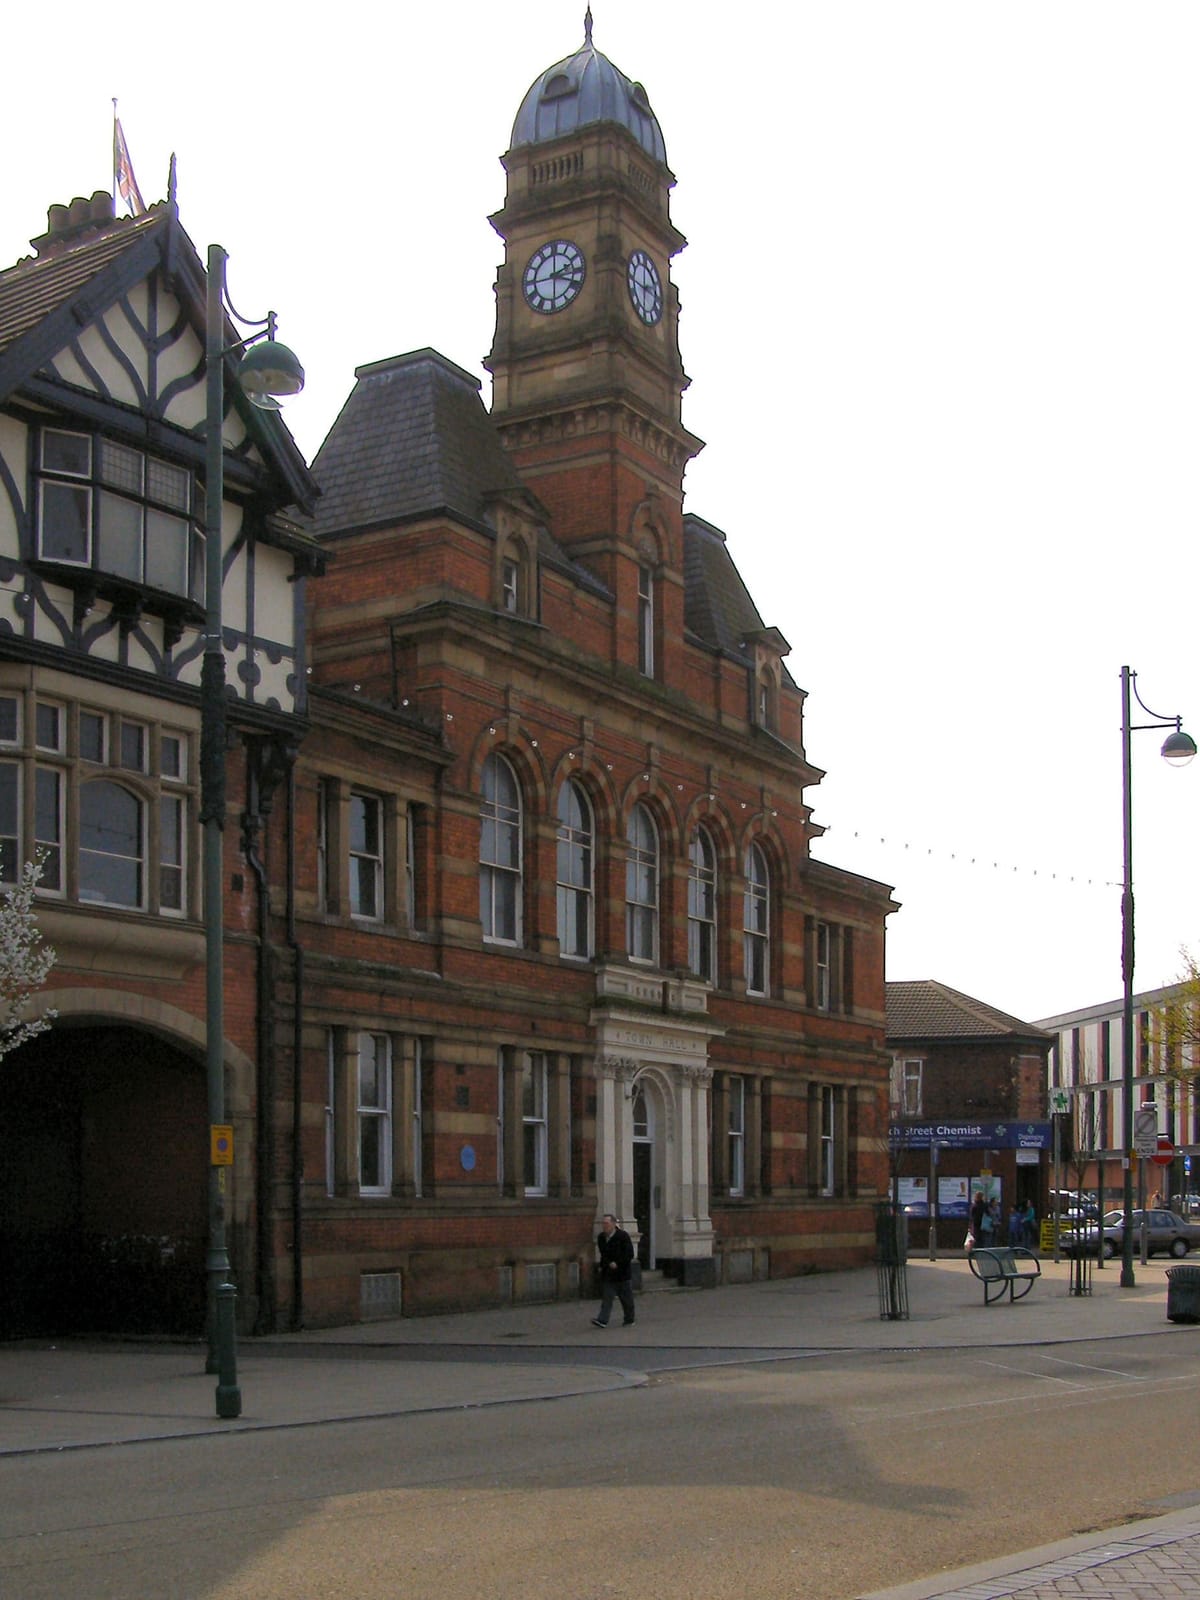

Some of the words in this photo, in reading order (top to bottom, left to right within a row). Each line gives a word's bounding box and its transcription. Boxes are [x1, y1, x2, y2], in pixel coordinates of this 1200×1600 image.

[625, 1031, 653, 1045] TOWN
[663, 1038, 687, 1050] HALL
[904, 1126, 933, 1136] Street
[936, 1125, 982, 1136] Chemist
